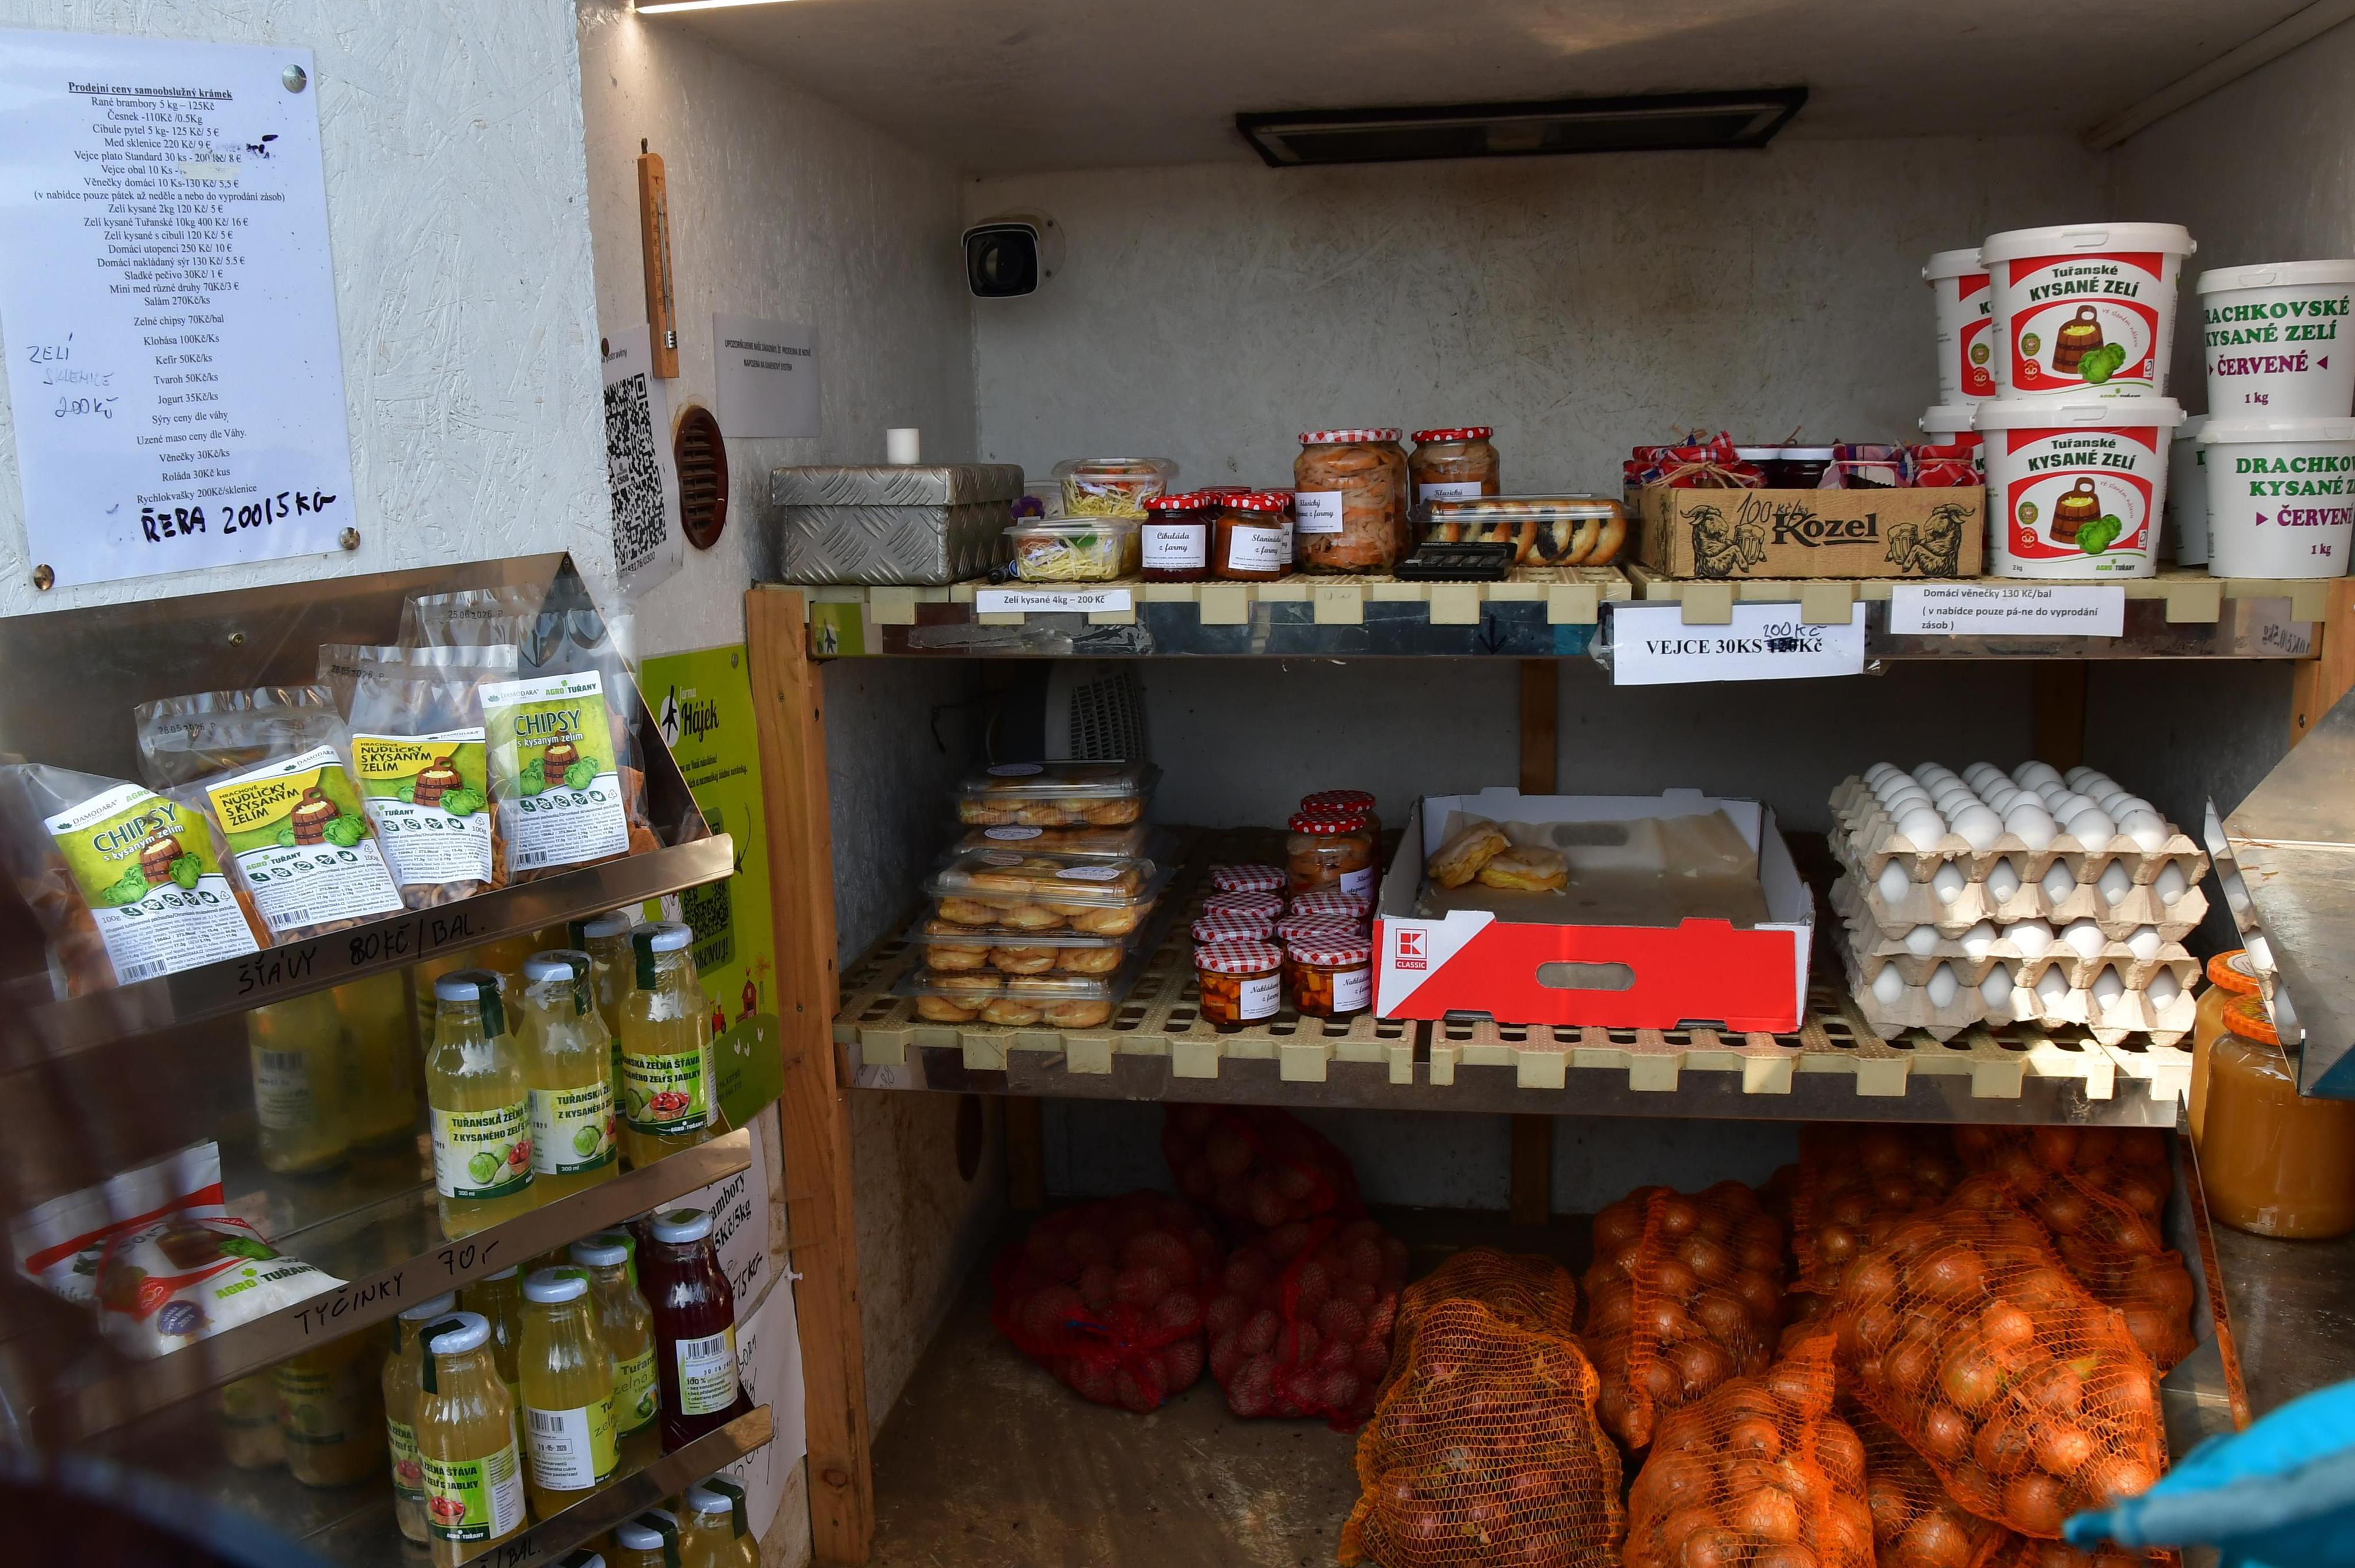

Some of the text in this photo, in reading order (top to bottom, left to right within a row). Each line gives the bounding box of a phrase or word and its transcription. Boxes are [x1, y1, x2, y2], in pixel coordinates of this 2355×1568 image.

[68, 82, 108, 94] Prodejní
[135, 87, 195, 97] samoobslužný
[199, 88, 232, 97] krámek
[91, 97, 215, 111] Rané brambory 125Kč
[107, 108, 139, 121] Česnek
[92, 124, 145, 137] Cibule pytel
[104, 138, 161, 148] Med sklenice
[74, 150, 162, 162] Vejce plato Standard
[101, 165, 146, 176] Vejce obal
[84, 177, 155, 188] Věnečky domácí
[46, 190, 285, 203] nabídce pouze pátek neděle nebo vyprodání zásob)
[108, 204, 157, 215] Zelí kysané
[84, 217, 173, 229] Zelí kysané Tuřanské
[104, 231, 184, 242] Zelí kysané cibulí
[108, 244, 179, 255] Domácí utopenci
[97, 257, 190, 268] Domácí nakládaný sýr
[124, 270, 183, 282] Sladké pečivo
[2052, 264, 2118, 278] Tuřanské
[110, 283, 201, 294] Mini med různé druhy
[2029, 278, 2141, 302] KYSANÉ ZELÍ
[144, 295, 211, 306] Salám 270Kč/ks
[134, 314, 224, 327] Zelné chipsy 70Kč/bal
[144, 334, 220, 346] Klobása 100Kč/Ks
[2205, 320, 2336, 348] KYSANÉ ZELÍ
[26, 333, 74, 364] ZELÍ
[180, 353, 213, 364] 50Kč/ks
[2217, 352, 2308, 376] ČERVENÉ
[153, 373, 218, 385] Tvaroh 50Kč/ks
[158, 392, 218, 406] Jogurt 35Kč/ks
[152, 414, 171, 426] Sýry
[173, 415, 193, 424] ceny
[195, 412, 207, 421] dle
[137, 434, 163, 445] Uzené
[189, 433, 207, 442] ceny
[210, 430, 222, 439] dle
[224, 428, 247, 438] Váhy.
[2051, 437, 2117, 450] Tuřanské
[159, 449, 230, 463] Věnečky 30Kč/ks
[2028, 452, 2136, 471] KYSANÉ ZELÍ
[162, 468, 231, 481] Roláda 30Kč kus
[2249, 474, 2343, 497] KYSANÉ
[137, 484, 257, 506] Rychlokvašky 200Kč/sklenice
[1314, 509, 1334, 519] farmy
[1736, 492, 1773, 524] 100
[1156, 531, 1189, 541] Cibuláda
[1772, 512, 1879, 547] Kozel
[1163, 543, 1188, 553] farmy
[1260, 547, 1278, 556] farmy
[1004, 594, 1105, 607] Zelí kysané 4kg 200 Kč
[1923, 587, 2052, 602] Domácí věnečky 130 Kč/bal
[1938, 606, 2098, 619] nabídce pouze pá-ne do vyprodání
[1921, 620, 1949, 630] zásob
[1646, 639, 1763, 655] VEJCE 30KS
[545, 686, 565, 696] AGRO
[566, 682, 597, 693] TUŘANY
[513, 708, 581, 738] CHIPSY
[681, 699, 719, 743] Hájek
[523, 732, 583, 748] kysaným zelím
[372, 750, 432, 762] KYSANÝM
[361, 760, 399, 773] ZELÍM
[125, 789, 150, 802] AGRO
[218, 785, 258, 800] HRACHOVÉ
[222, 782, 285, 807] NUDLIČKY
[236, 788, 299, 813] KYSANÝM
[229, 808, 268, 826] ZELÍM
[384, 808, 414, 817] TUŘANY
[93, 802, 177, 853] CHIPSY
[112, 823, 184, 862] kysaným zelím
[246, 851, 301, 871] AGRO TUŘANY
[102, 914, 121, 923] 100g
[238, 946, 317, 995] ŠŤÁVY
[674, 1056, 700, 1069] ŠŤÁVA
[675, 1069, 700, 1082] JABLKY
[556, 1088, 602, 1105] TUŘANSKÁ
[452, 1109, 501, 1128] TUŘANSKÁ
[460, 1128, 506, 1142] KYSANÉHO
[215, 1278, 258, 1300] AGRO
[294, 1271, 403, 1335] TYČINKY
[446, 1463, 477, 1476] ŠŤÁVA
